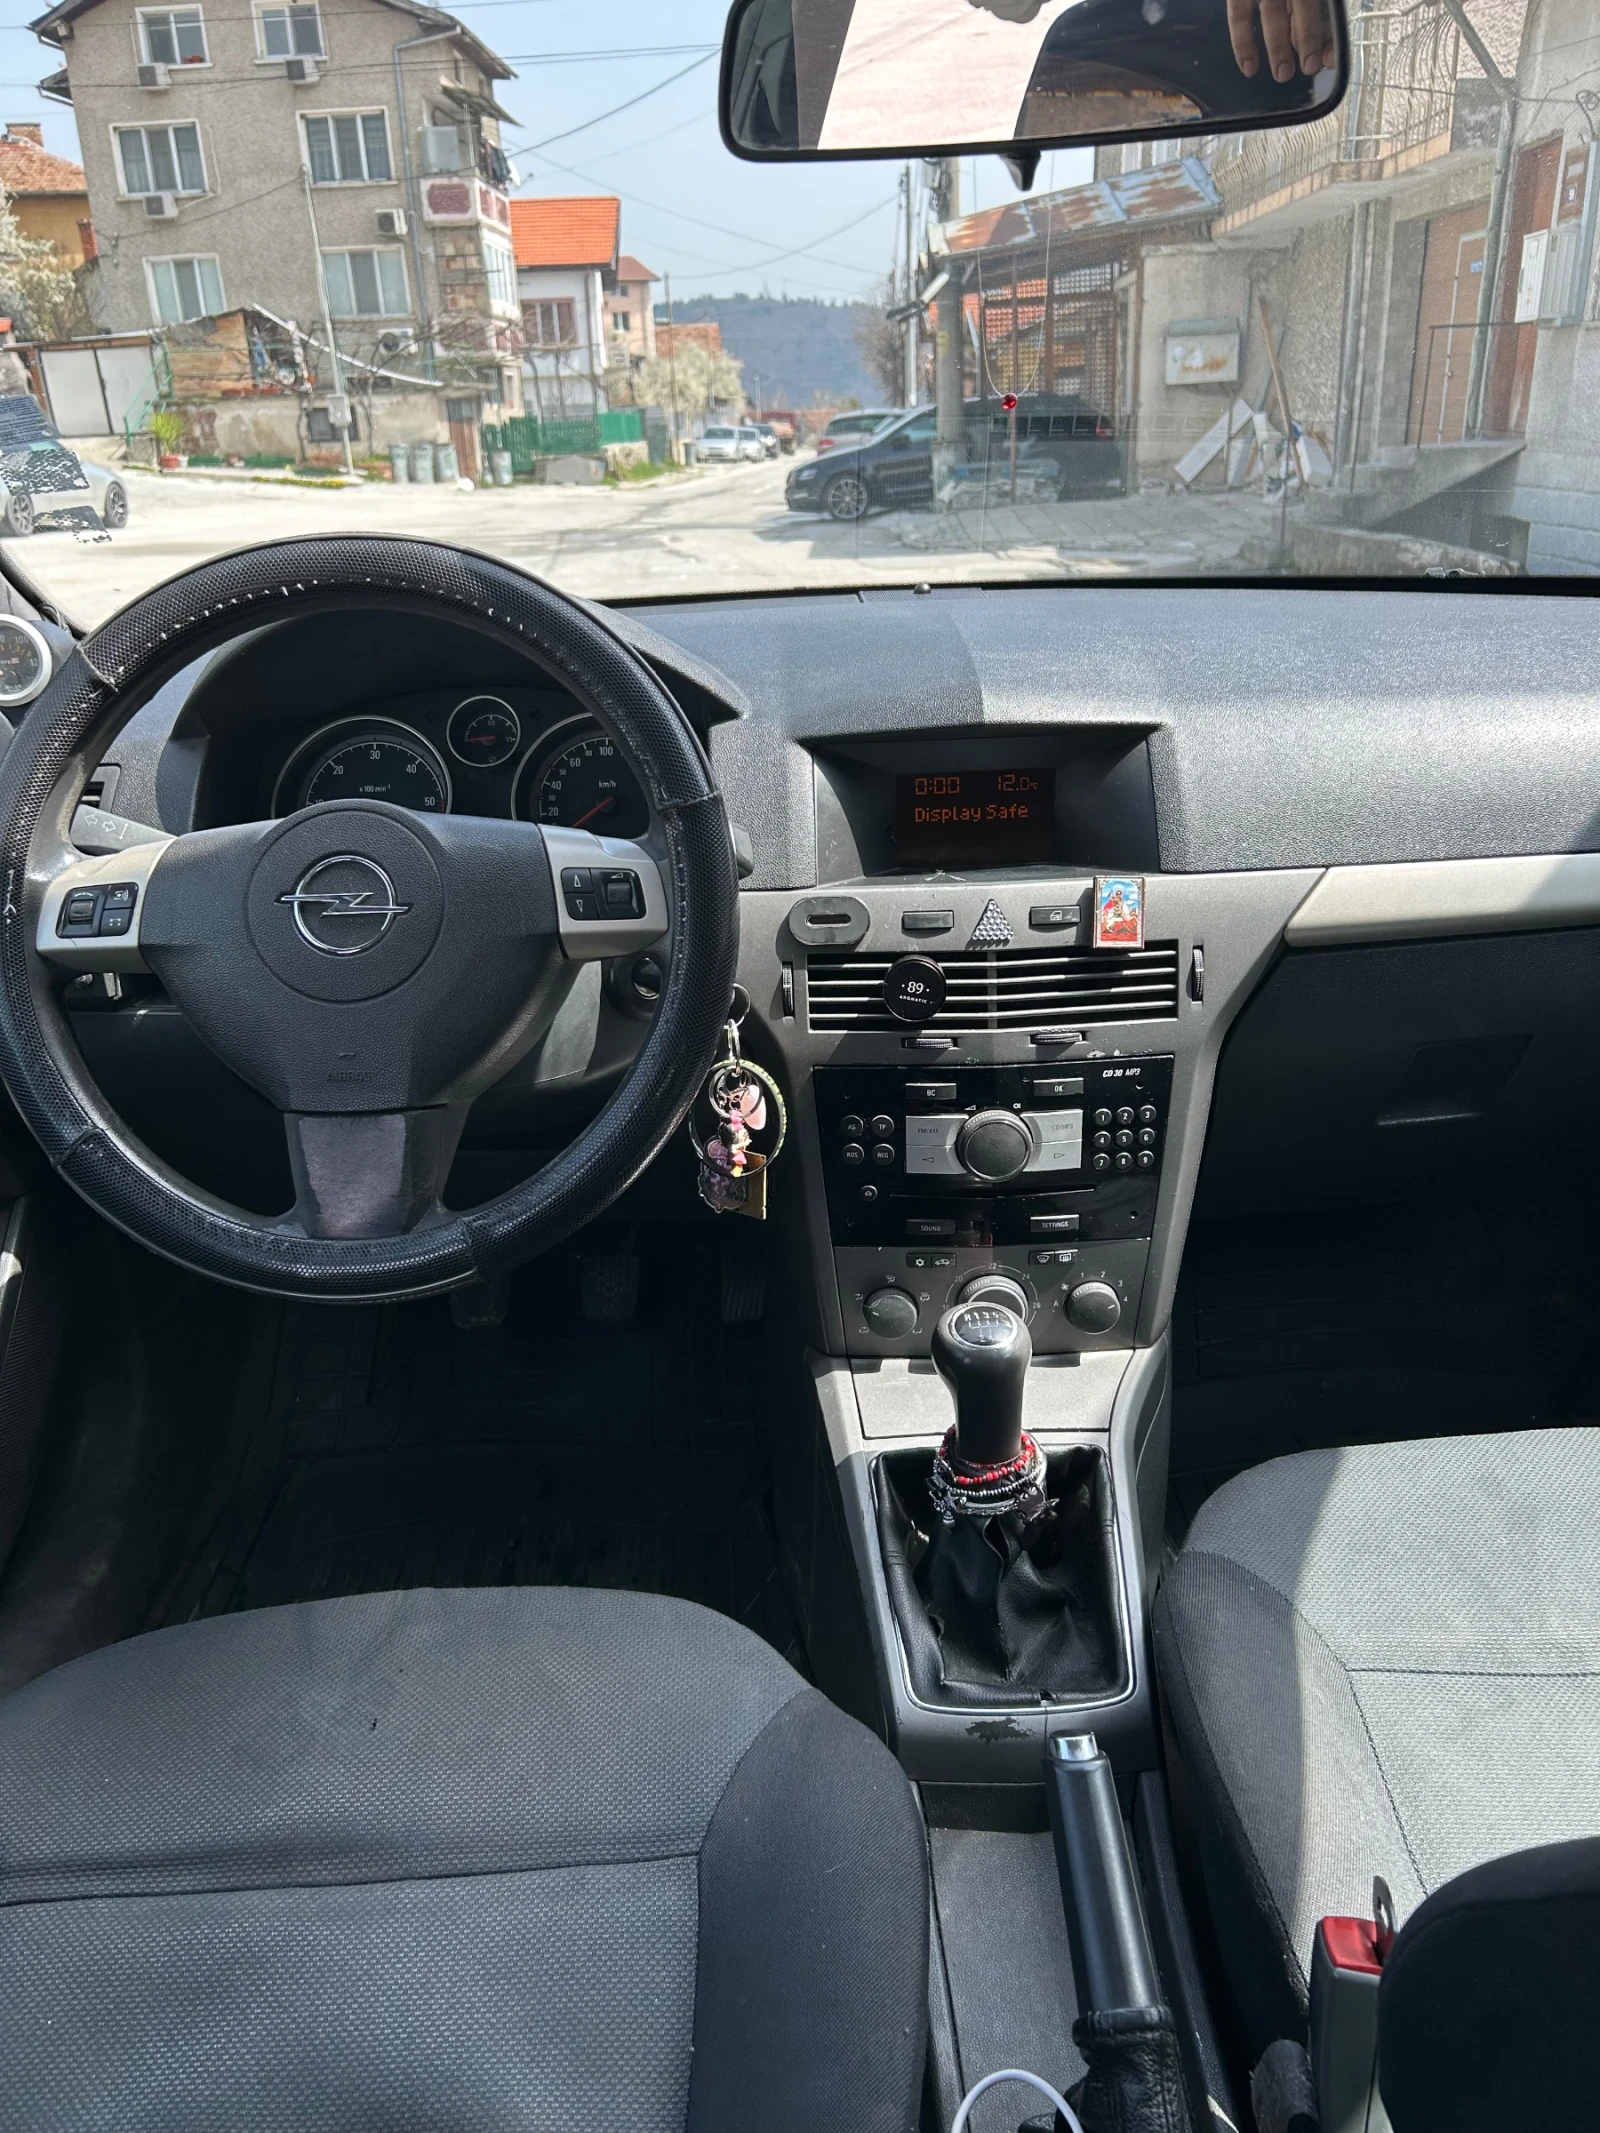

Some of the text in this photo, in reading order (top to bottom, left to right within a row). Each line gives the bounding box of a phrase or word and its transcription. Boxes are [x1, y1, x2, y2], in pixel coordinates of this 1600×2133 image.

[369, 750, 381, 760] 30
[599, 746, 614, 756] 100
[569, 758, 581, 767] 60
[333, 765, 344, 775] 20
[406, 764, 417, 774] 40
[364, 785, 375, 793] 100
[551, 781, 562, 790] 40
[598, 780, 617, 788] km/h
[915, 776, 960, 795] 0:00
[424, 797, 436, 807] 50
[548, 794, 556, 802] 30
[548, 807, 559, 817] 20
[915, 803, 1028, 823] Display Safe
[907, 981, 924, 994] 89
[1102, 1067, 1141, 1078] CD 30 MP3
[926, 1089, 936, 1097] BC
[1054, 1085, 1063, 1093] OK
[1041, 1221, 1069, 1229] SETTINGS
